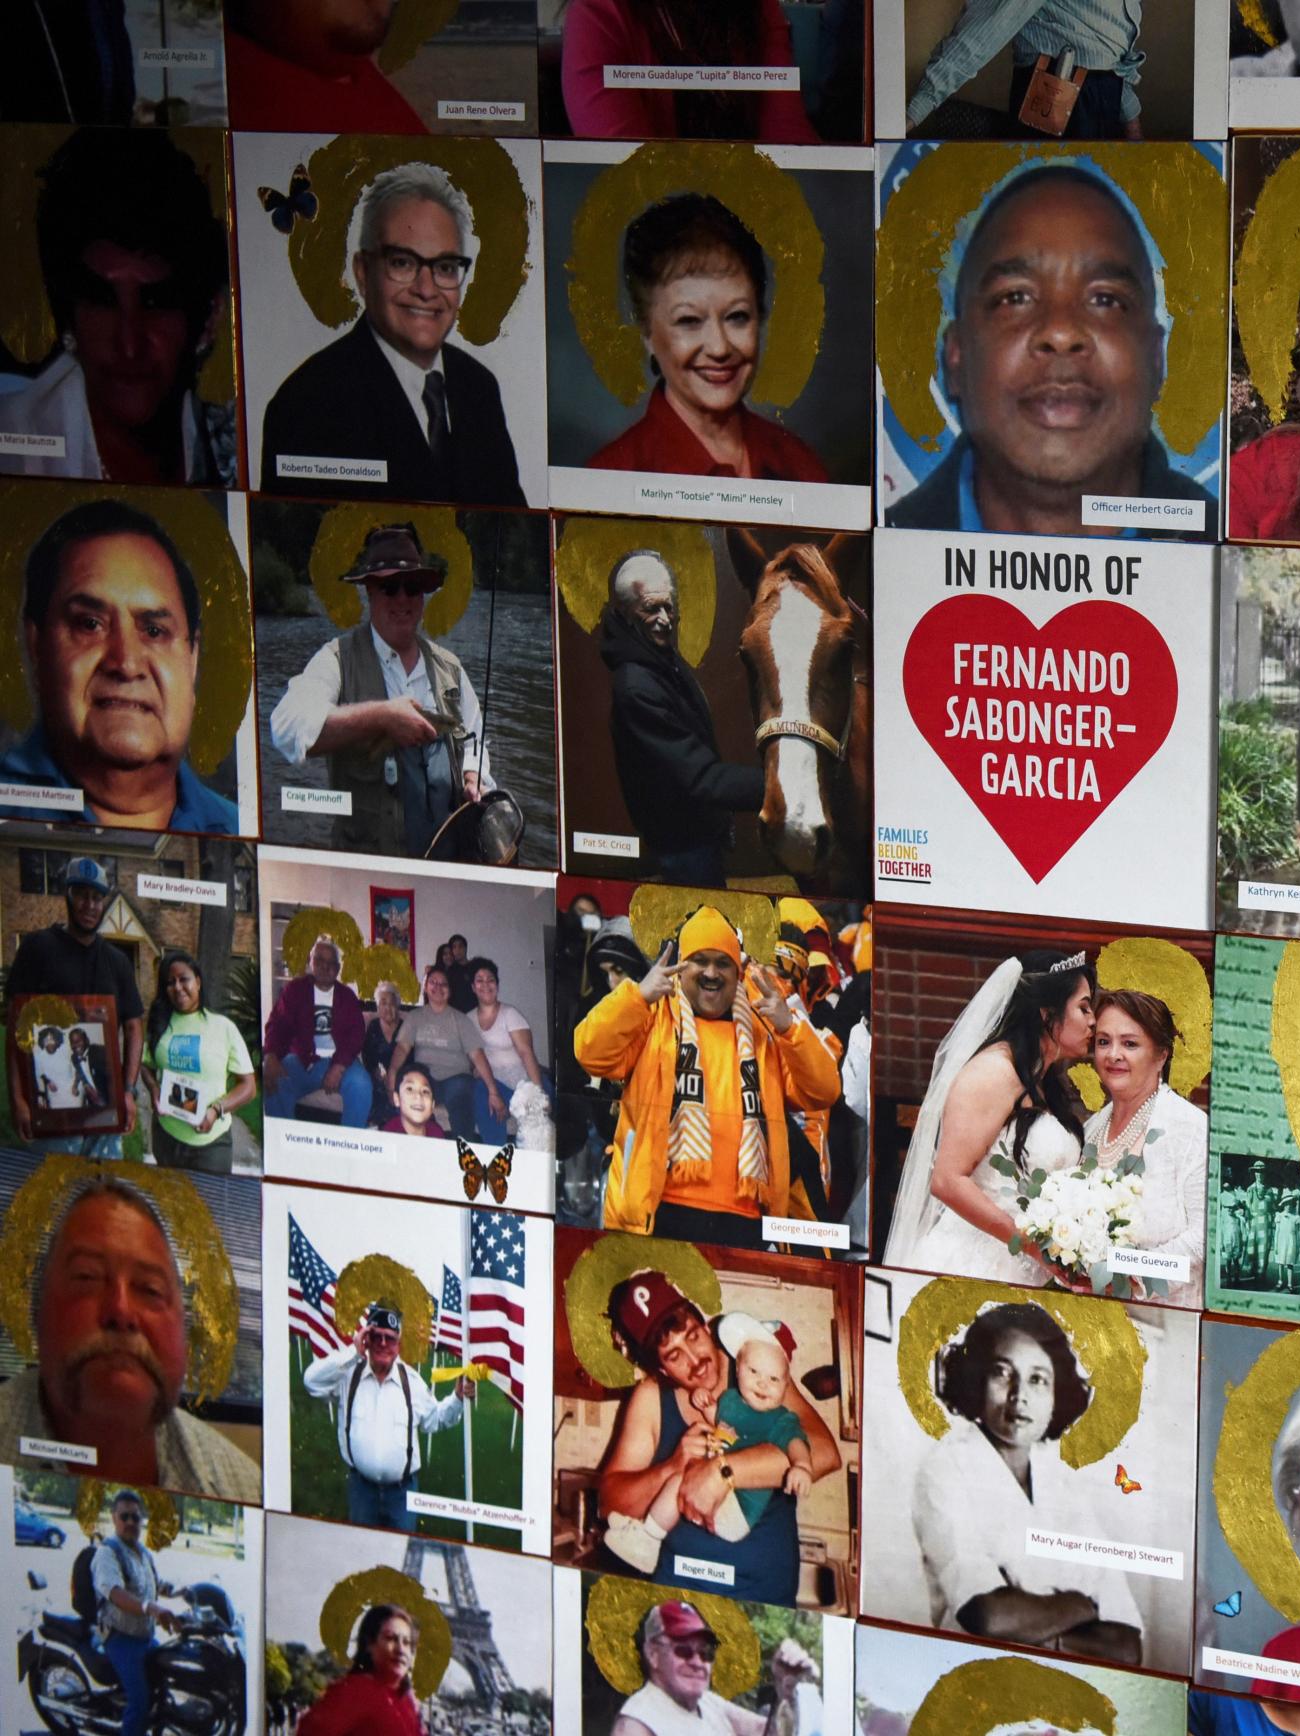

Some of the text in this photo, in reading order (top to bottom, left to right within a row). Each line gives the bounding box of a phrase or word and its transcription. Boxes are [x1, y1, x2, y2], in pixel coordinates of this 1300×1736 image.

[612, 70, 646, 80] Morena
[648, 70, 694, 82] Guadalupe
[732, 71, 761, 80] Blanco
[764, 72, 788, 80] Perez
[446, 105, 517, 116] Juan Rene Olvera
[281, 463, 382, 477] Roberto Tadeo Donaldson
[641, 488, 674, 500] Marilyn
[749, 496, 784, 506] Hensley
[1091, 502, 1193, 516] Officer Herbert Garcia
[944, 547, 1142, 596] IN HONOR OF
[953, 642, 1130, 696] FERNANDO
[981, 751, 1102, 803] GARCIA
[42, 790, 75, 802] Martinez
[286, 790, 342, 804] Craig Plumhoff
[583, 838, 593, 848] Pat
[878, 826, 929, 845] FAMILIES
[878, 844, 918, 861] BELONG
[878, 860, 932, 878] TOGETHER
[143, 880, 216, 897] Mary Bradley-Davis
[1247, 886, 1285, 899] Kathryn
[285, 1132, 384, 1154] Vicente & Francisca Lopez
[770, 1222, 840, 1238] George Longoria
[1114, 1252, 1179, 1269] Rosie Guevara
[28, 1442, 58, 1454] Michael
[414, 1497, 447, 1511] Clarence
[1031, 1533, 1174, 1565] Mary Augar (Feronberg) Stewart
[682, 1562, 726, 1579] Roger Rust
[1215, 1655, 1254, 1670] Beatrice
[1255, 1662, 1288, 1677] Nadine
